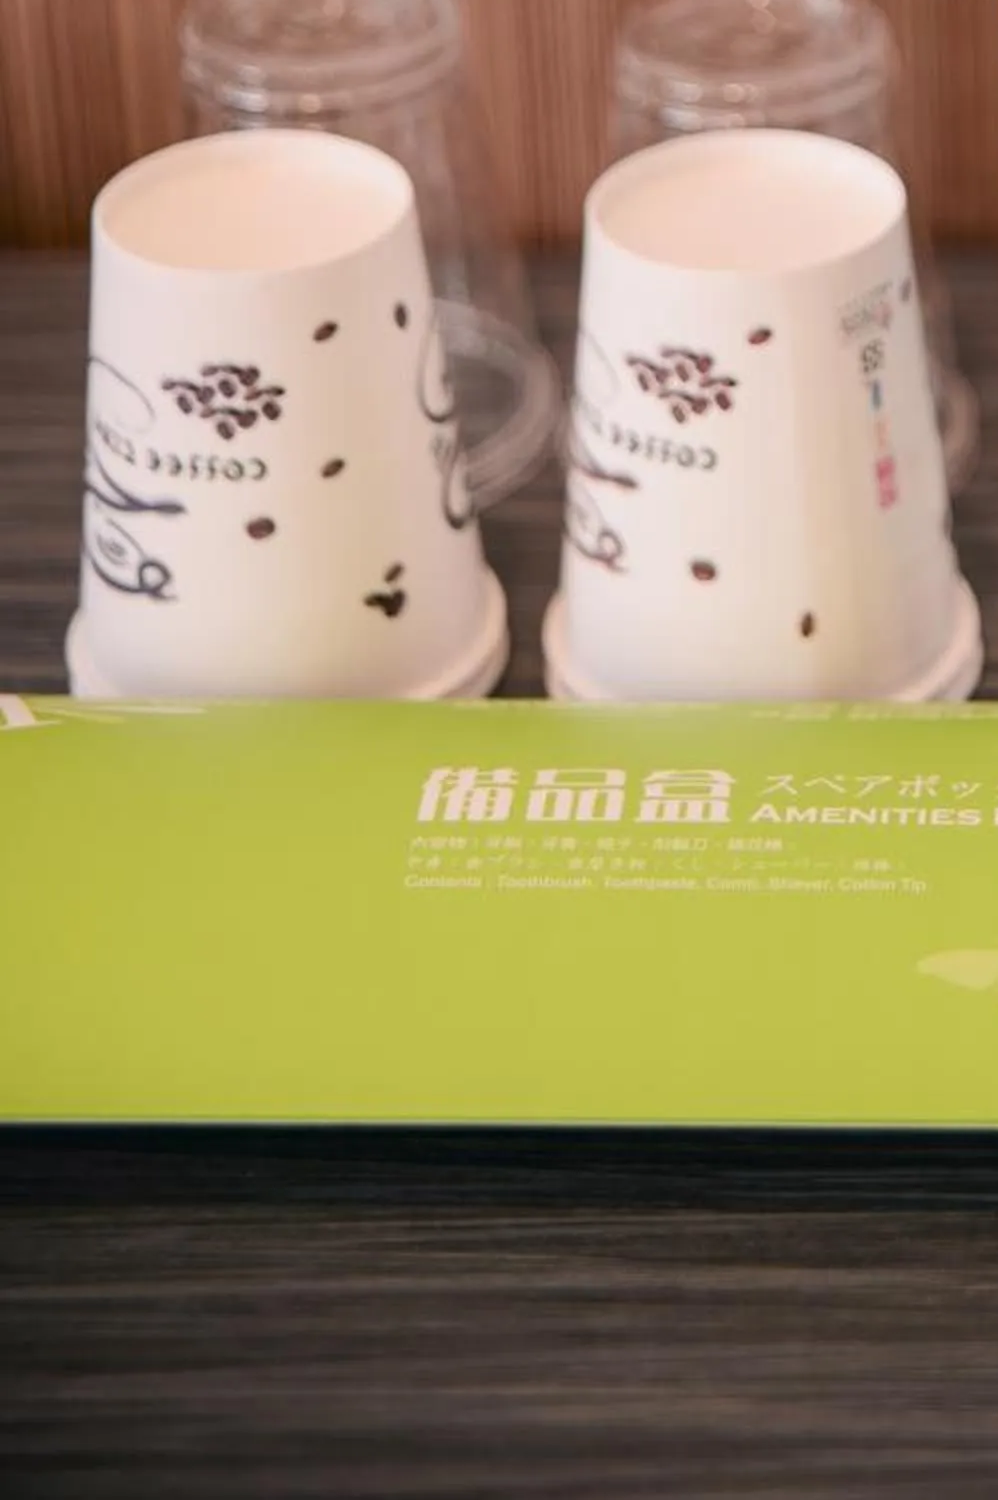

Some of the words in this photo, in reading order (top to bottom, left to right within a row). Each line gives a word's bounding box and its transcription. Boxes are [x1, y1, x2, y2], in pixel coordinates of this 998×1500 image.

[417, 766, 737, 823] 備品盒
[750, 802, 983, 827] AMENITIES
